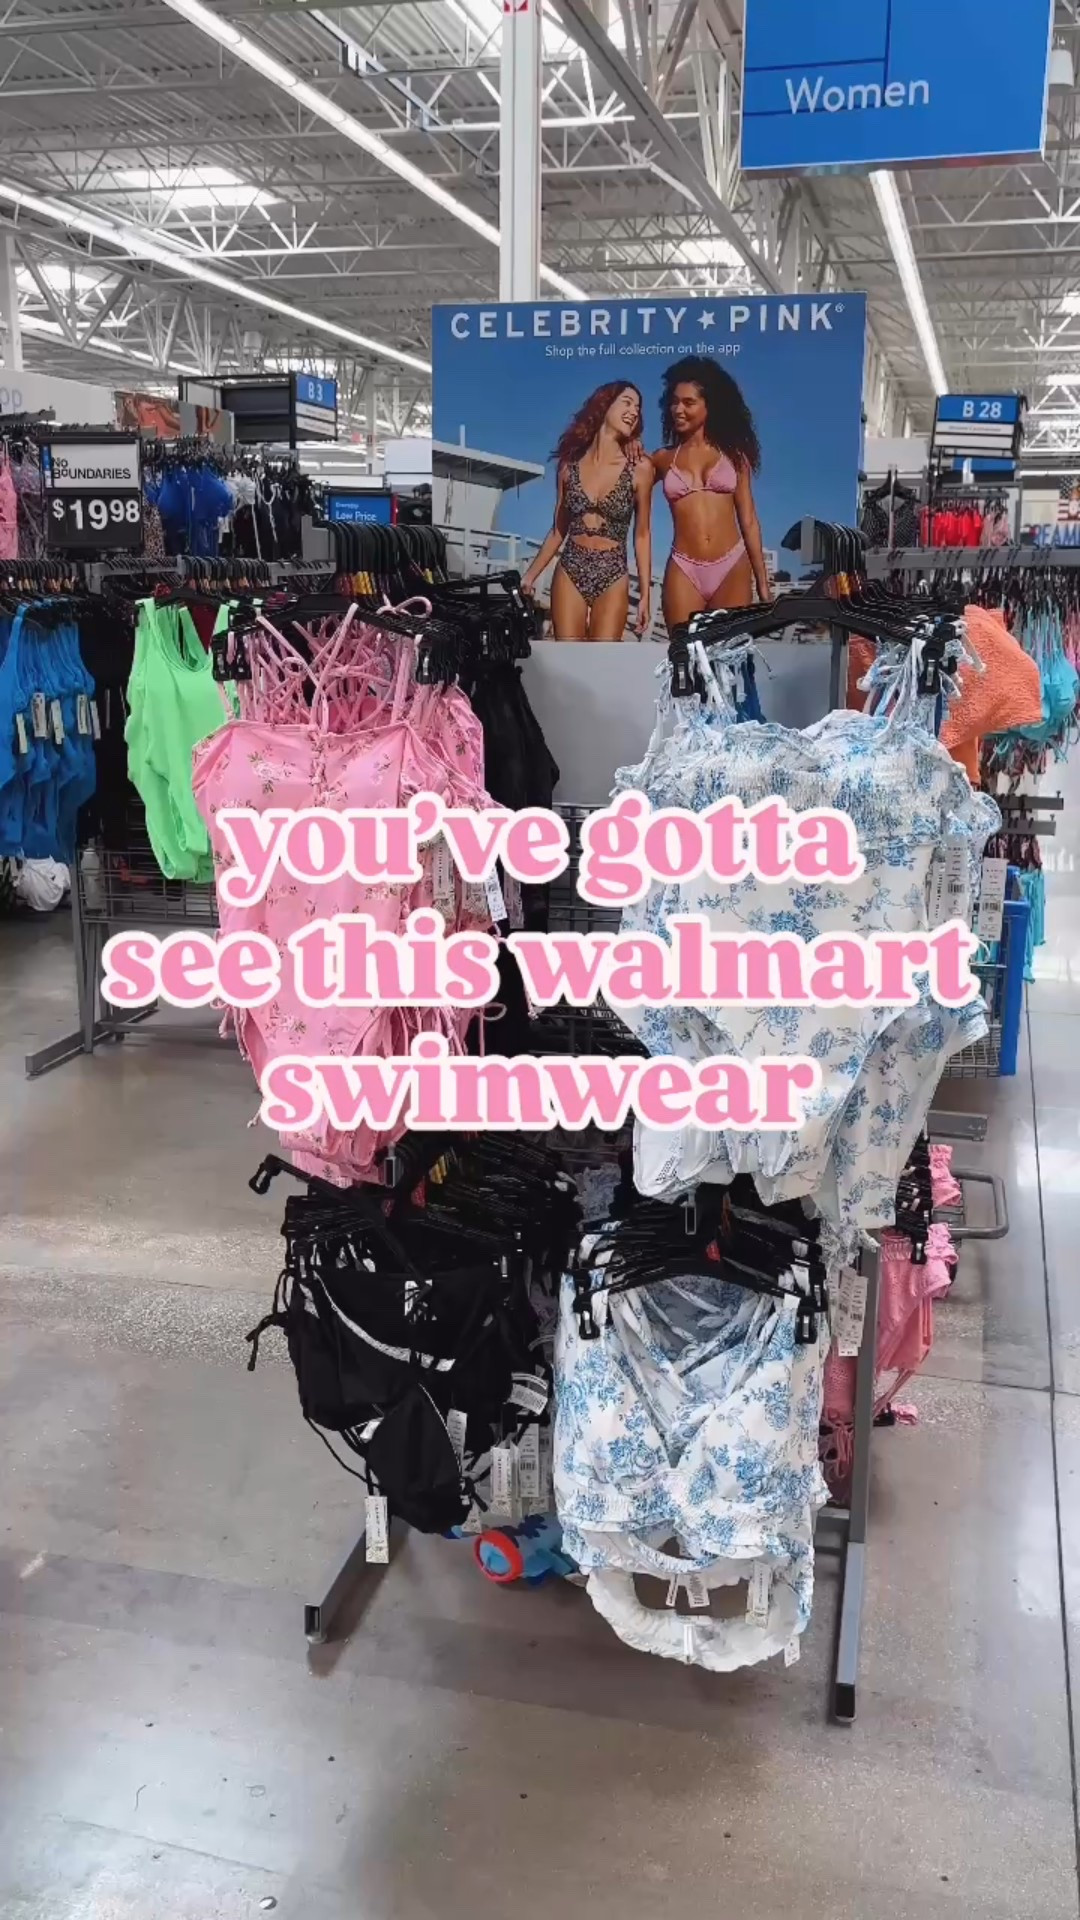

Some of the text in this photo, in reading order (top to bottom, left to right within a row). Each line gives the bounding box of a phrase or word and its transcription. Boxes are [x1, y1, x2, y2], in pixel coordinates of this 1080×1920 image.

[785, 75, 930, 115] Women
[450, 306, 688, 339] CELEBRITY
[545, 342, 741, 359] Shop the full collection on the app
[962, 400, 1002, 418] B 28
[335, 511, 378, 521] Low Price
